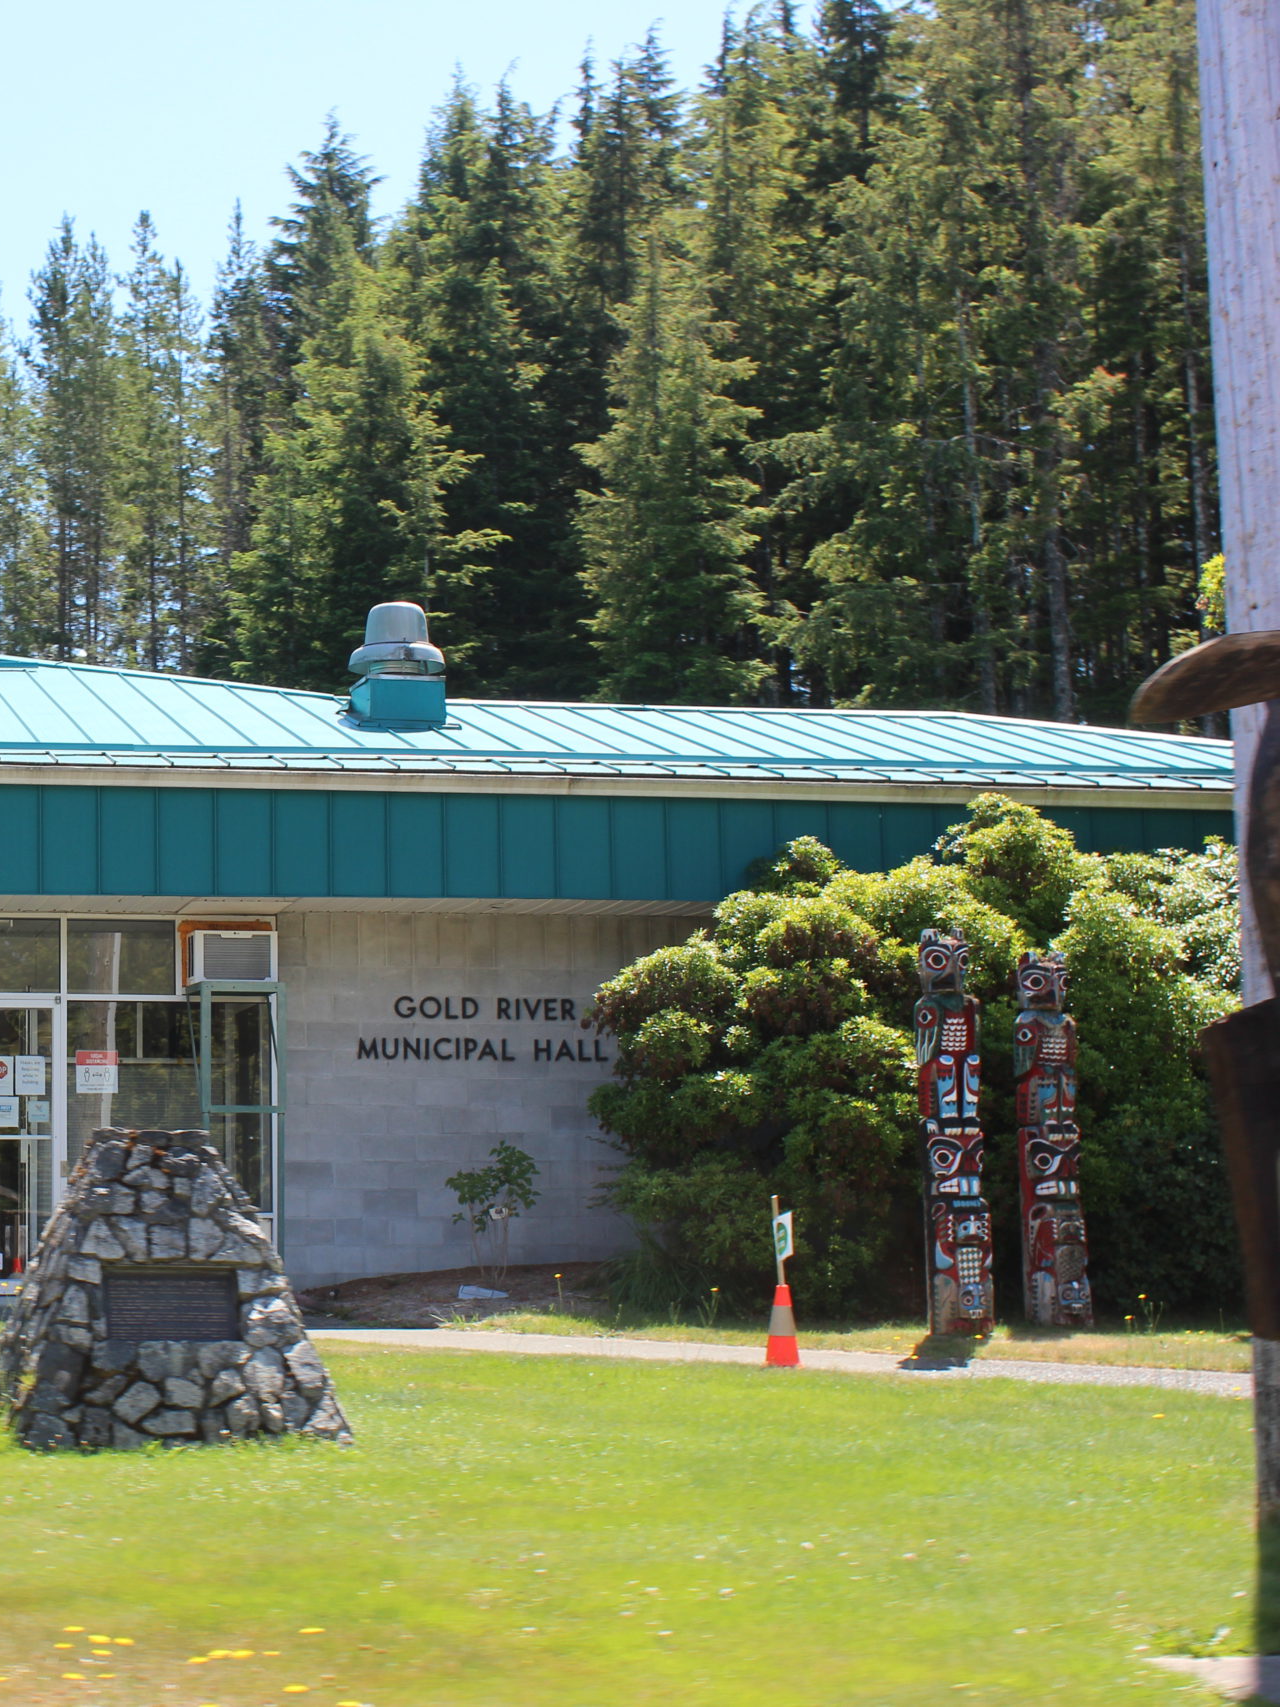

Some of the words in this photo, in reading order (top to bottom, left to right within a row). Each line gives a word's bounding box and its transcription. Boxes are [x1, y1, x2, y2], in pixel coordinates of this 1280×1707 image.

[393, 995, 479, 1019] GOLD
[496, 998, 577, 1021] RIVER
[357, 1037, 516, 1062] MUNICIPAL
[533, 1038, 609, 1062] HALL
